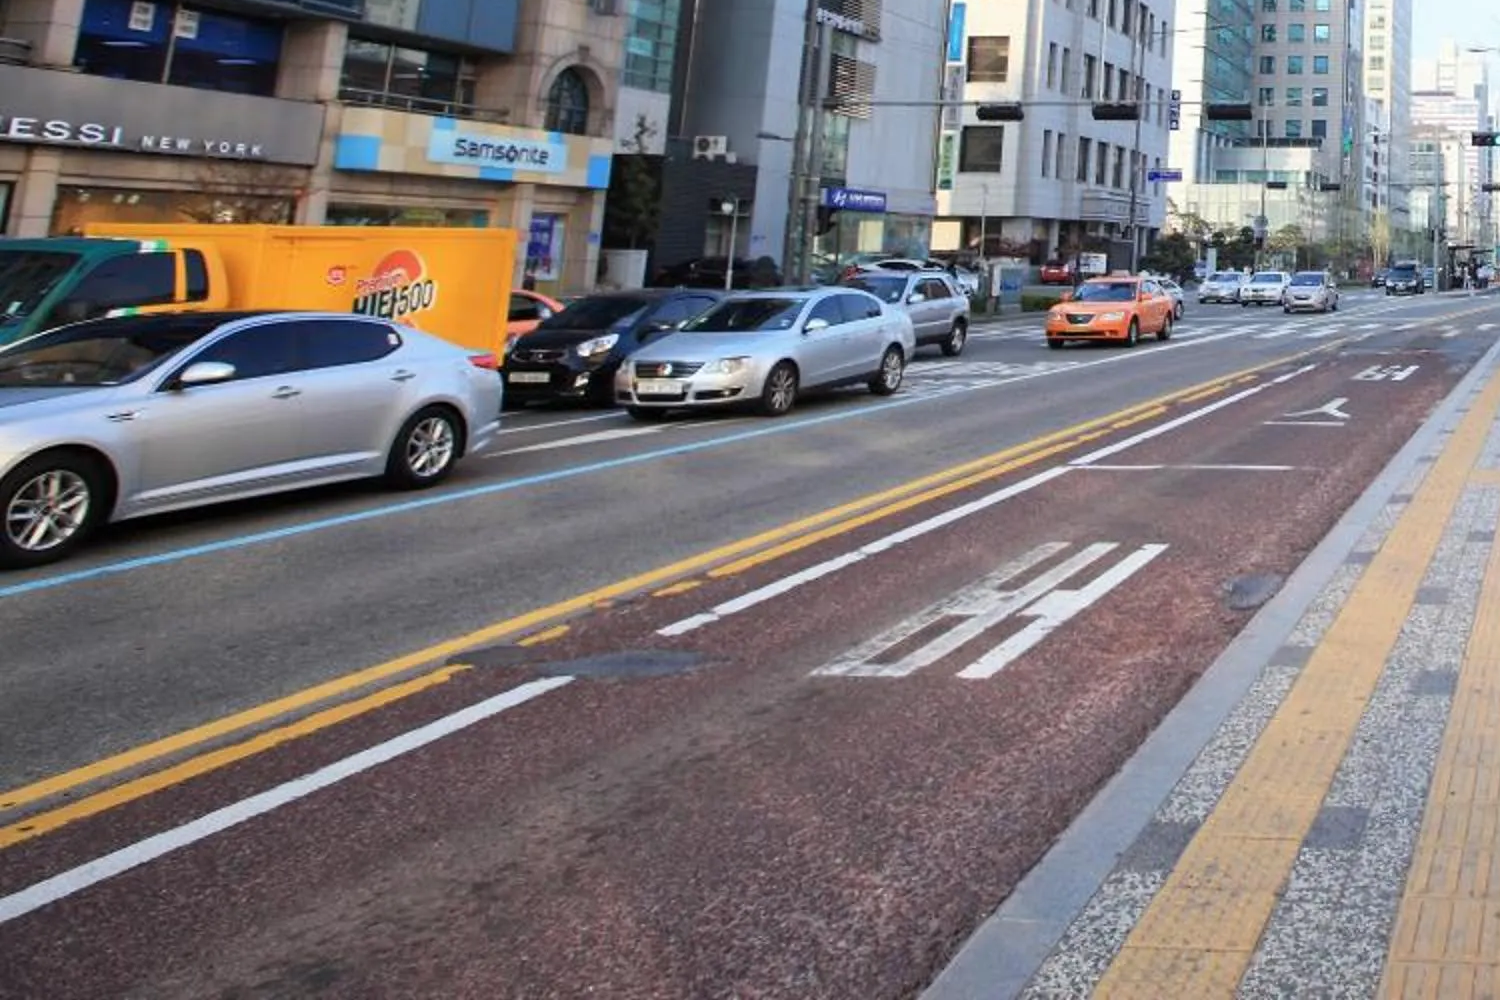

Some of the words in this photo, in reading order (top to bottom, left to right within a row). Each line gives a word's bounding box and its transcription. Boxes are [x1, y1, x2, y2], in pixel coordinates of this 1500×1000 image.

[141, 134, 191, 150] NEW
[203, 140, 263, 156] YORK
[453, 138, 550, 166] Samsonite
